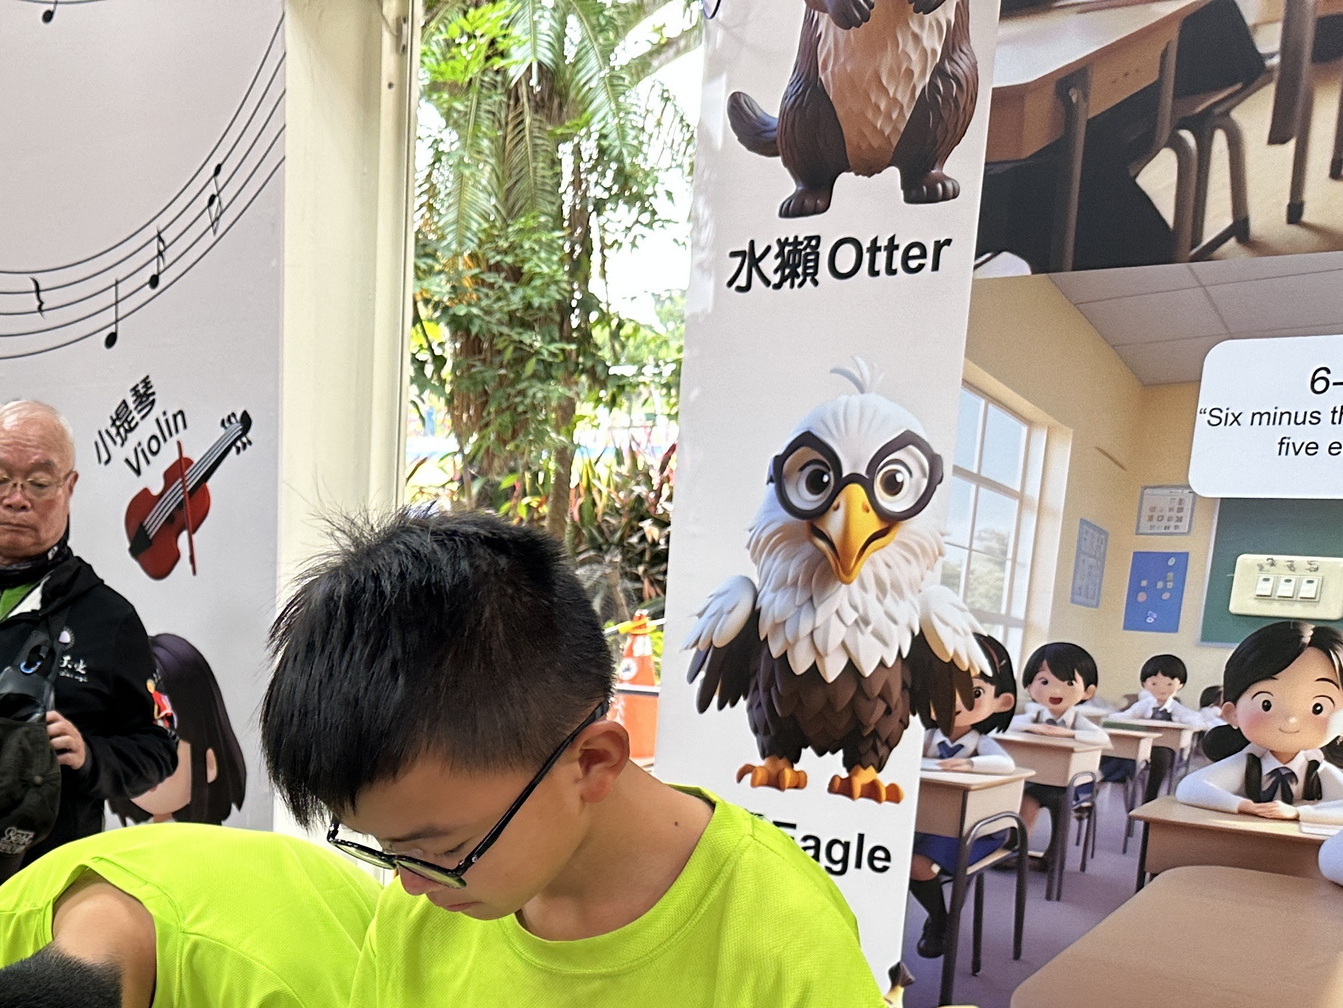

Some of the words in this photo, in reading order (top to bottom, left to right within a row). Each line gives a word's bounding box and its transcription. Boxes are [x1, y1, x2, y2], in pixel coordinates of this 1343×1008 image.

[726, 235, 821, 293] 水獺
[828, 234, 953, 280] Otter
[94, 375, 156, 466] 小提琴
[124, 409, 187, 477] Violin
[1250, 406, 1322, 426] minus
[1277, 436, 1319, 456] five
